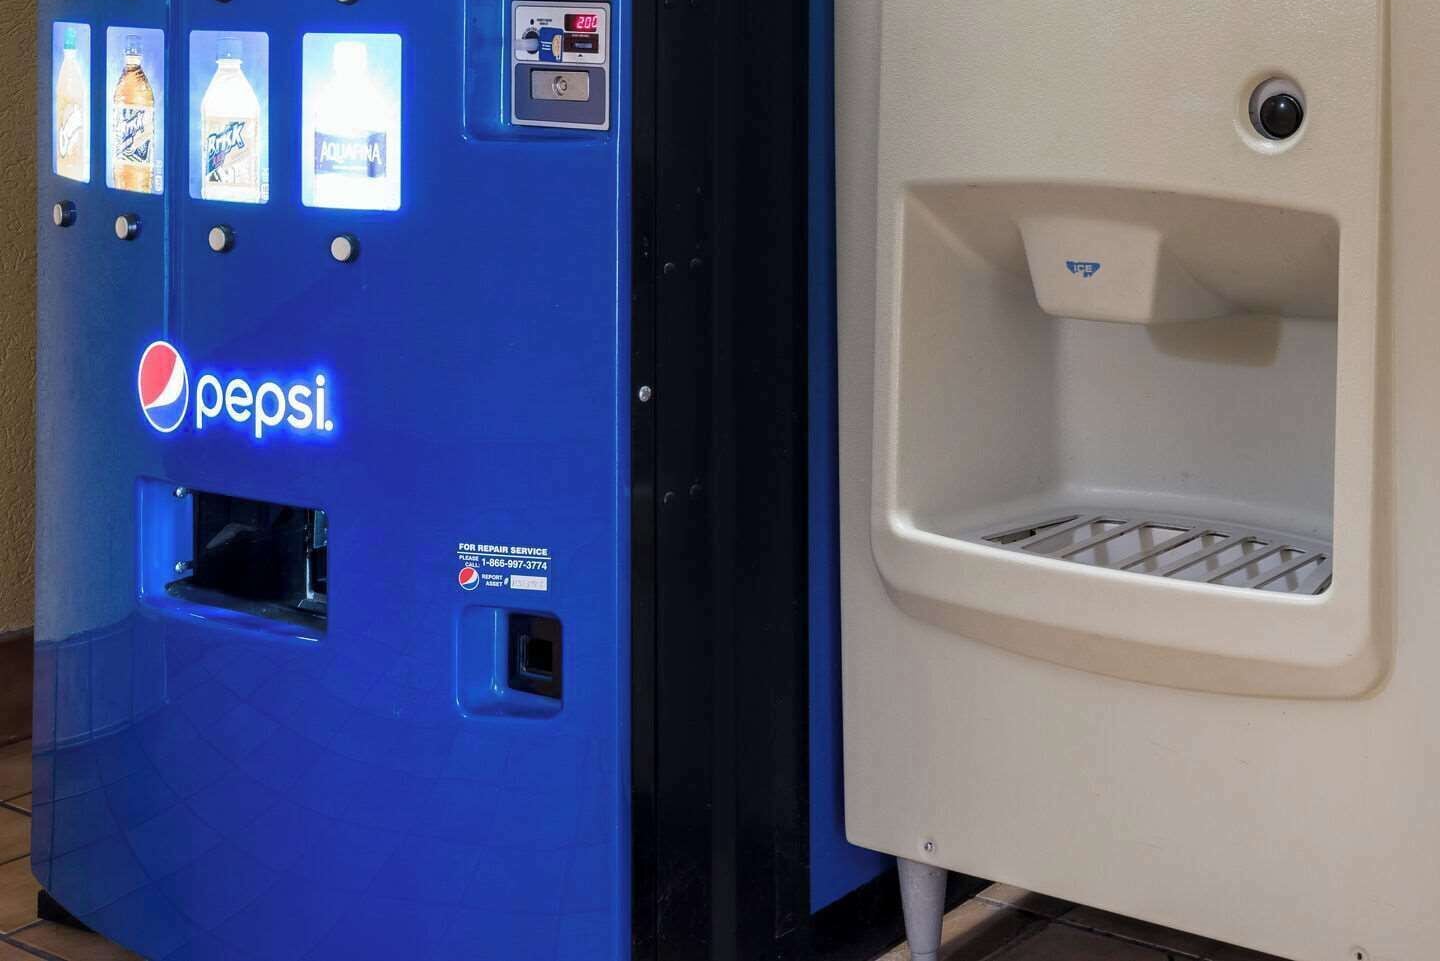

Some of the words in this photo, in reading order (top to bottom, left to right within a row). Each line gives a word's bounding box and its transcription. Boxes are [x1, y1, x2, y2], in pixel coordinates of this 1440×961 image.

[319, 141, 382, 165] AQUAFINA
[1073, 264, 1092, 273] ICE
[459, 543, 475, 551] FOR
[478, 544, 508, 553] REPAIR
[511, 546, 548, 556] SERVICE
[481, 558, 547, 570] 1-866-997-3774
